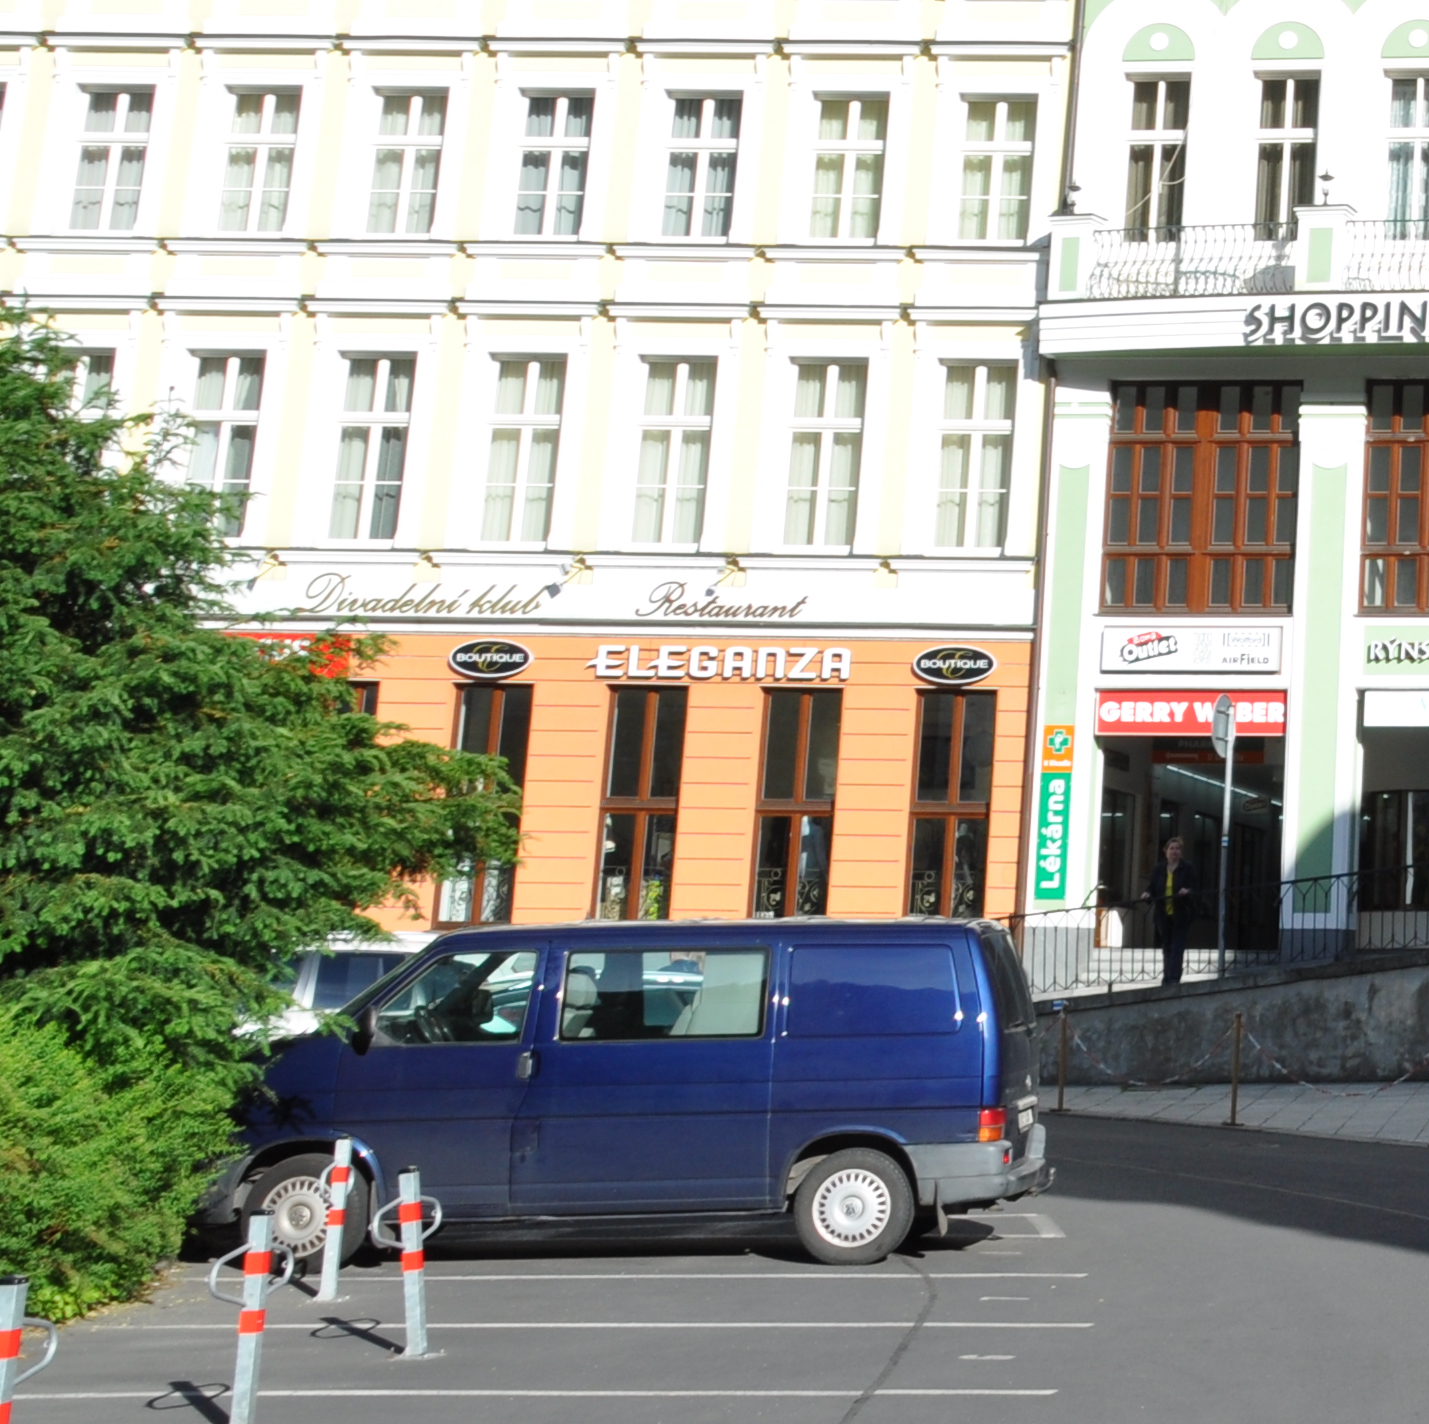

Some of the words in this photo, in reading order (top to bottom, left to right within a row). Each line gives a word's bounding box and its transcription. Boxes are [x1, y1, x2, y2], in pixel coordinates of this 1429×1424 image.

[294, 572, 469, 615] Divadelní
[466, 584, 545, 615] klub
[635, 581, 809, 618] Restaurant
[456, 653, 525, 663] BOUTIQUE
[585, 644, 852, 680] ELEGANZA
[920, 658, 989, 669] BOUTIQUE
[1121, 636, 1177, 663] Outlet
[1100, 701, 1189, 723] GERRY
[1193, 702, 1285, 723] WBER
[1039, 778, 1066, 889] Lékárna
